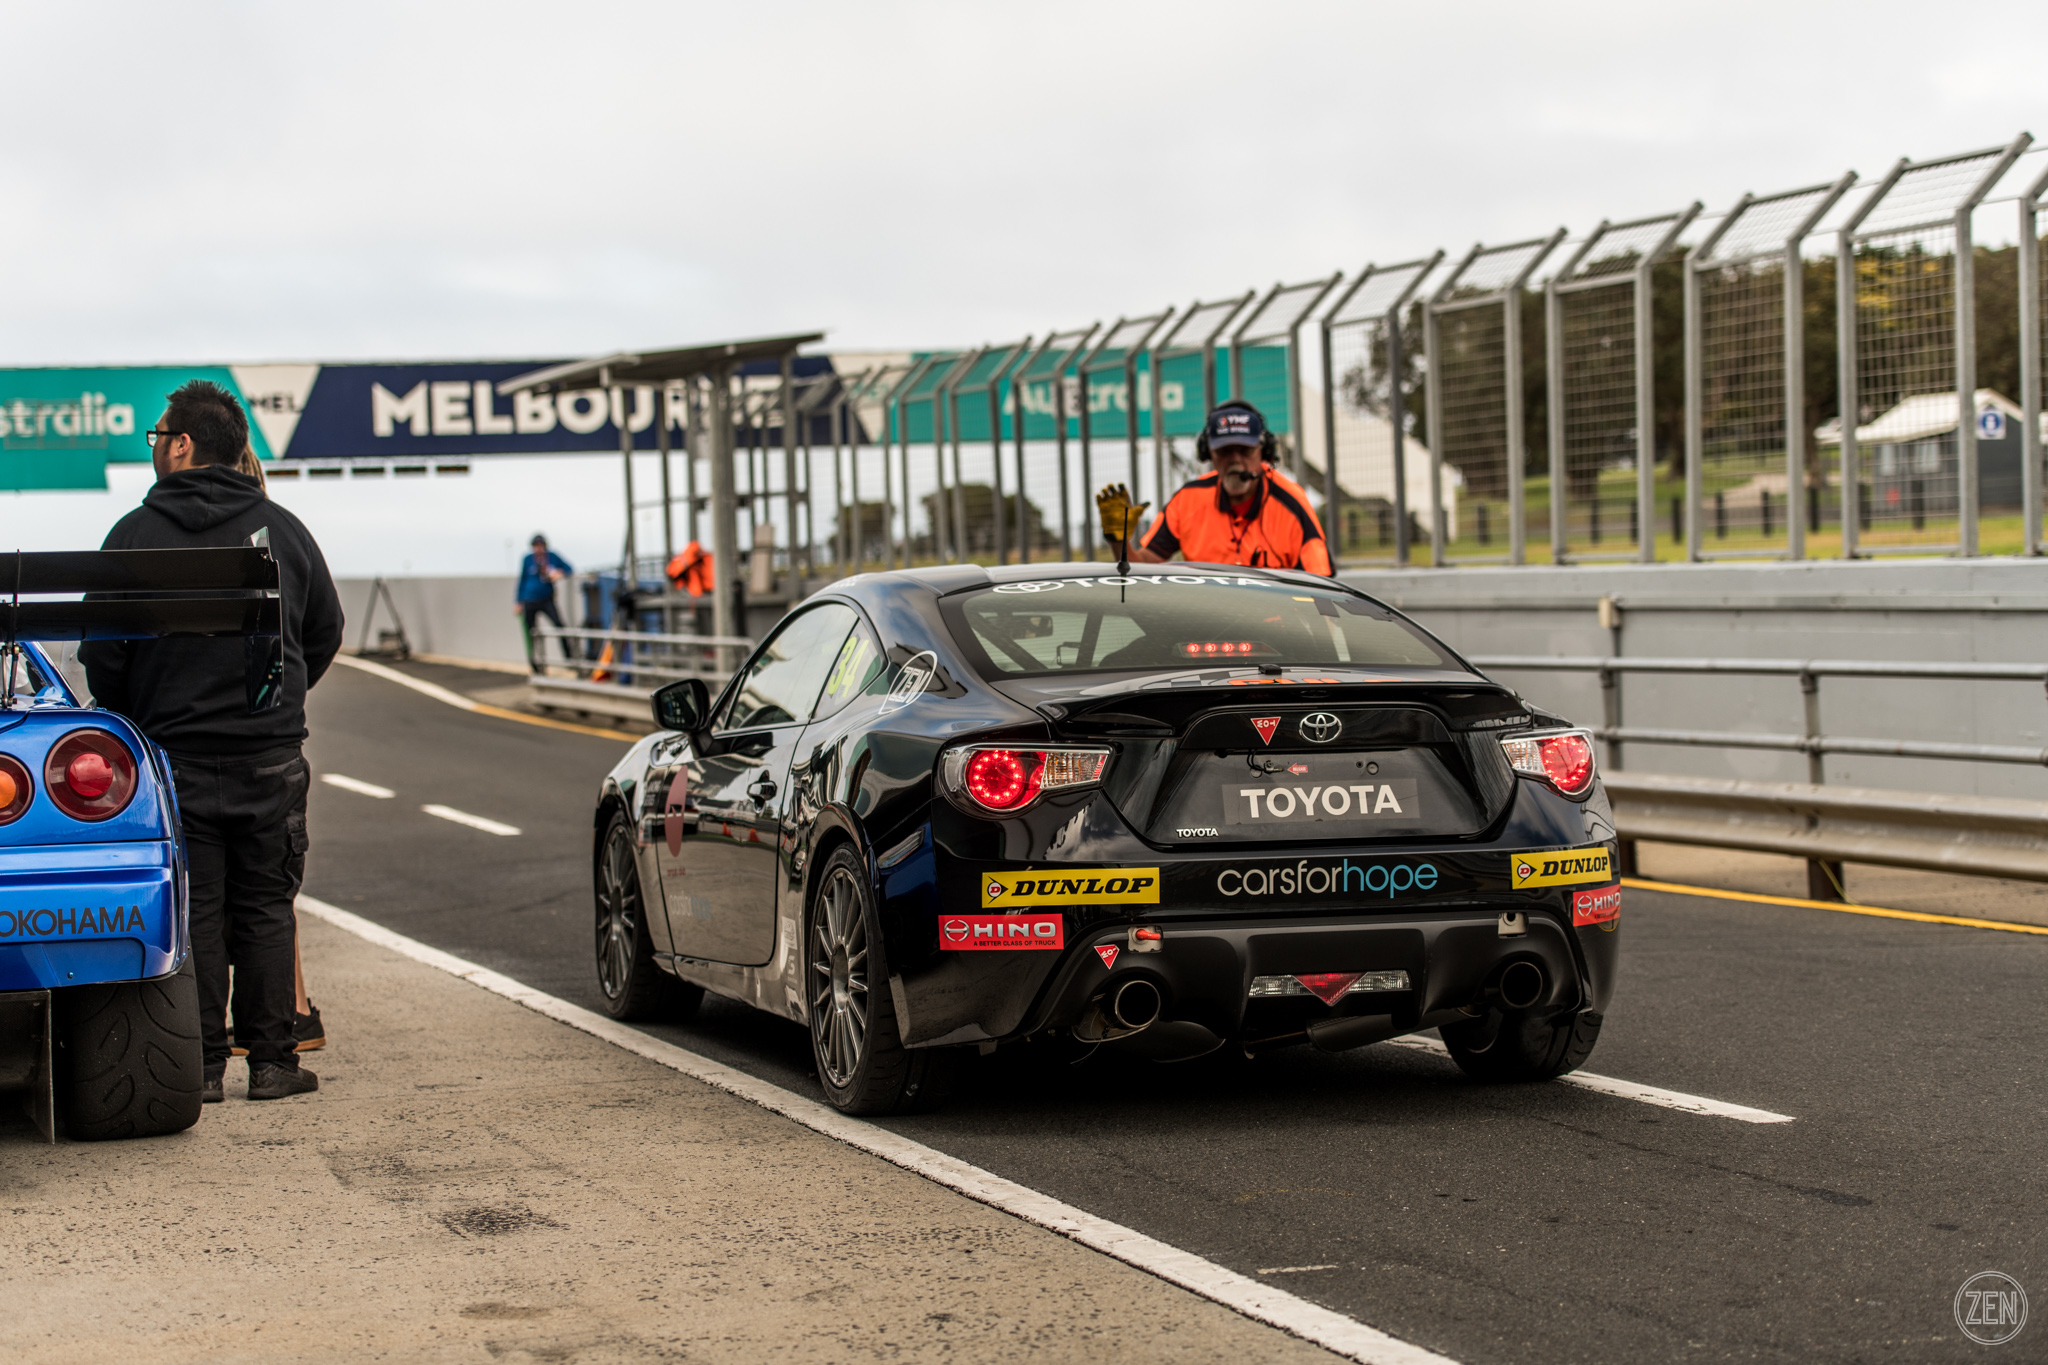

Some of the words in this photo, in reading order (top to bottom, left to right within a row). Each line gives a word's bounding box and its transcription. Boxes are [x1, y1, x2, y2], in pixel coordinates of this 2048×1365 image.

[1068, 576, 1272, 587] TOYOTA
[827, 636, 869, 698] 34
[888, 666, 930, 703] ZEN
[1240, 784, 1403, 818] TOYOTA
[1176, 827, 1219, 838] TOYOTA
[1540, 856, 1608, 877] DUNLOP
[1010, 877, 1154, 897] DUNLOP
[1217, 858, 1439, 899] carsforhope
[1594, 892, 1620, 911] HINO
[0, 905, 146, 937] OKOHAMA
[973, 922, 1056, 938] HINO
